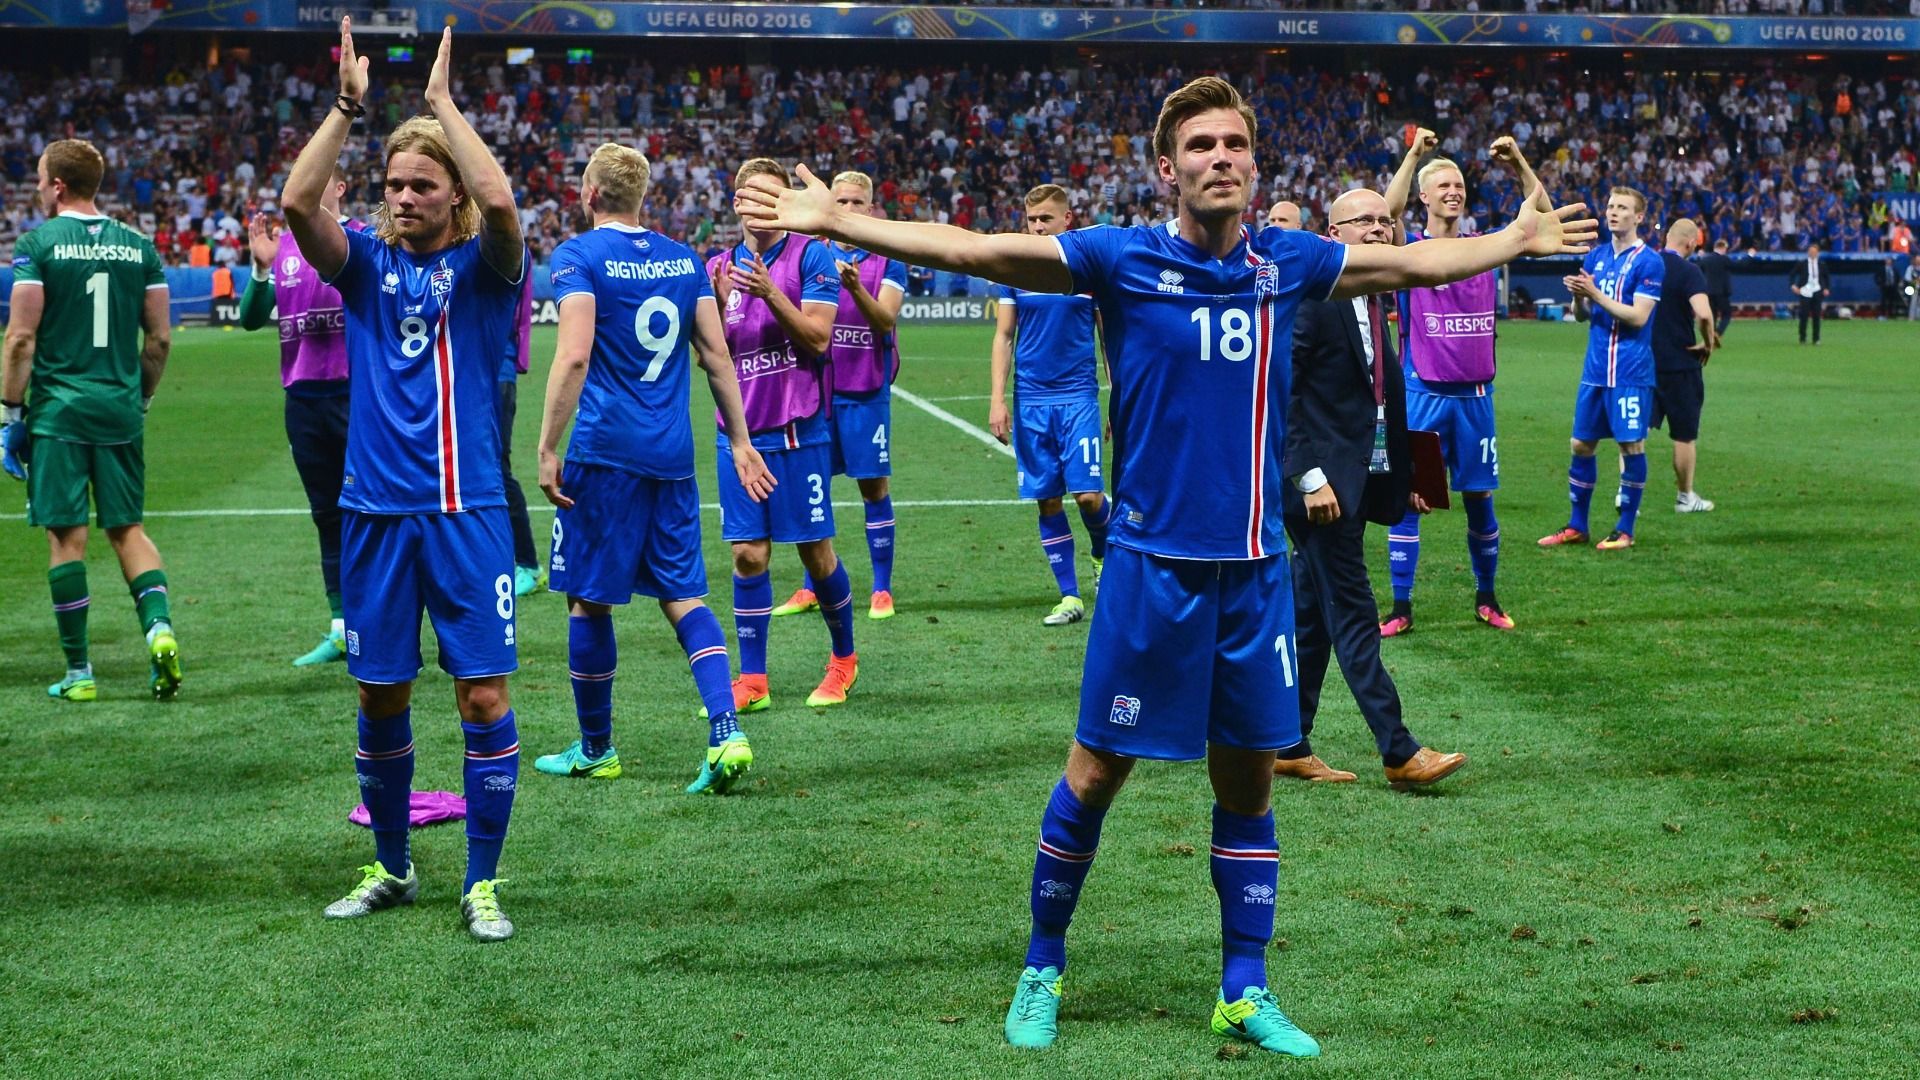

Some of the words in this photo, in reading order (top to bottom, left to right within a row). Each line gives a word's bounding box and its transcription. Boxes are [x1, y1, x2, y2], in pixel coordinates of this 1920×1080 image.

[647, 12, 700, 27] UEFA
[704, 13, 759, 28] EURO
[762, 13, 812, 29] 2016
[1278, 20, 1318, 35] NICE
[1760, 26, 1806, 40] UEFA
[1810, 26, 1858, 41] EURO
[1861, 26, 1905, 41] 2016
[1891, 199, 1920, 221] NI
[605, 258, 695, 280] SIGTHÓRSSON
[433, 281, 451, 294] KS
[1599, 279, 1615, 300] 15
[86, 272, 109, 348] 1
[216, 305, 240, 320] TU
[898, 302, 982, 319] onald's
[297, 313, 344, 334] RSPEC
[1191, 307, 1252, 361] 18
[400, 316, 429, 358] 8
[635, 296, 680, 381] 9
[834, 329, 872, 344] SPEC
[741, 345, 797, 375] RESPEC
[1618, 396, 1640, 419] 15
[872, 424, 887, 449] 4
[1079, 437, 1100, 463] 11
[1480, 436, 1497, 464] 19
[807, 474, 824, 505] 3
[552, 517, 563, 552] 9
[495, 574, 513, 620] 8
[1275, 632, 1299, 687] 1
